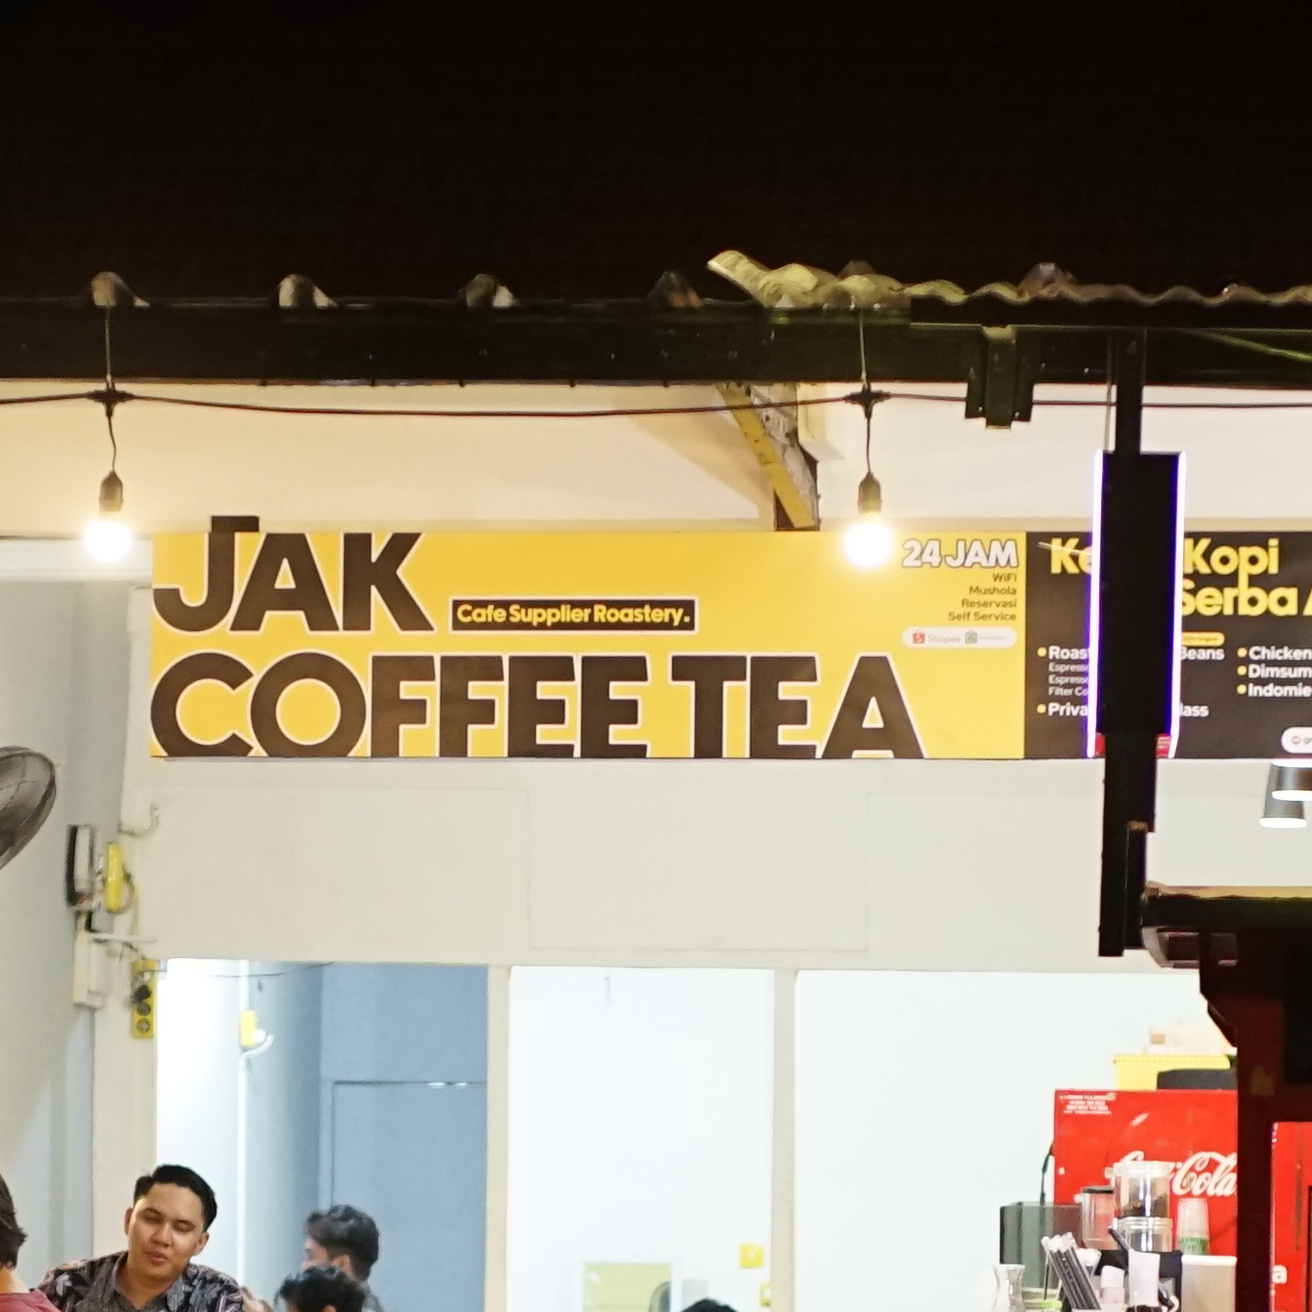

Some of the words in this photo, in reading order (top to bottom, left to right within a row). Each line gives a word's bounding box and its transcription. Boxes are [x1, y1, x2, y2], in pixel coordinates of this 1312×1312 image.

[901, 538, 942, 569] 24
[943, 538, 1019, 569] JAM
[1183, 538, 1280, 587] Kopi
[152, 531, 435, 632] JAK
[992, 573, 1017, 583] WiFi
[969, 585, 1017, 596] Mushola
[1181, 578, 1298, 616] Serba
[961, 599, 1017, 609] Reservasi
[457, 604, 507, 623] Cafe
[509, 604, 590, 626] Supplier
[593, 604, 691, 626] Roastery.
[948, 611, 971, 621] Self
[973, 611, 1017, 622] Service
[1049, 646, 1088, 660] Roas
[1181, 647, 1225, 660] Beans
[1248, 646, 1312, 661] Chicken
[1248, 664, 1312, 679] Dimsum
[1248, 683, 1312, 697] Indomie
[151, 652, 650, 758] COFFEE
[671, 654, 926, 758] TEA
[1048, 702, 1088, 717] Priva
[1180, 703, 1209, 717] lass
